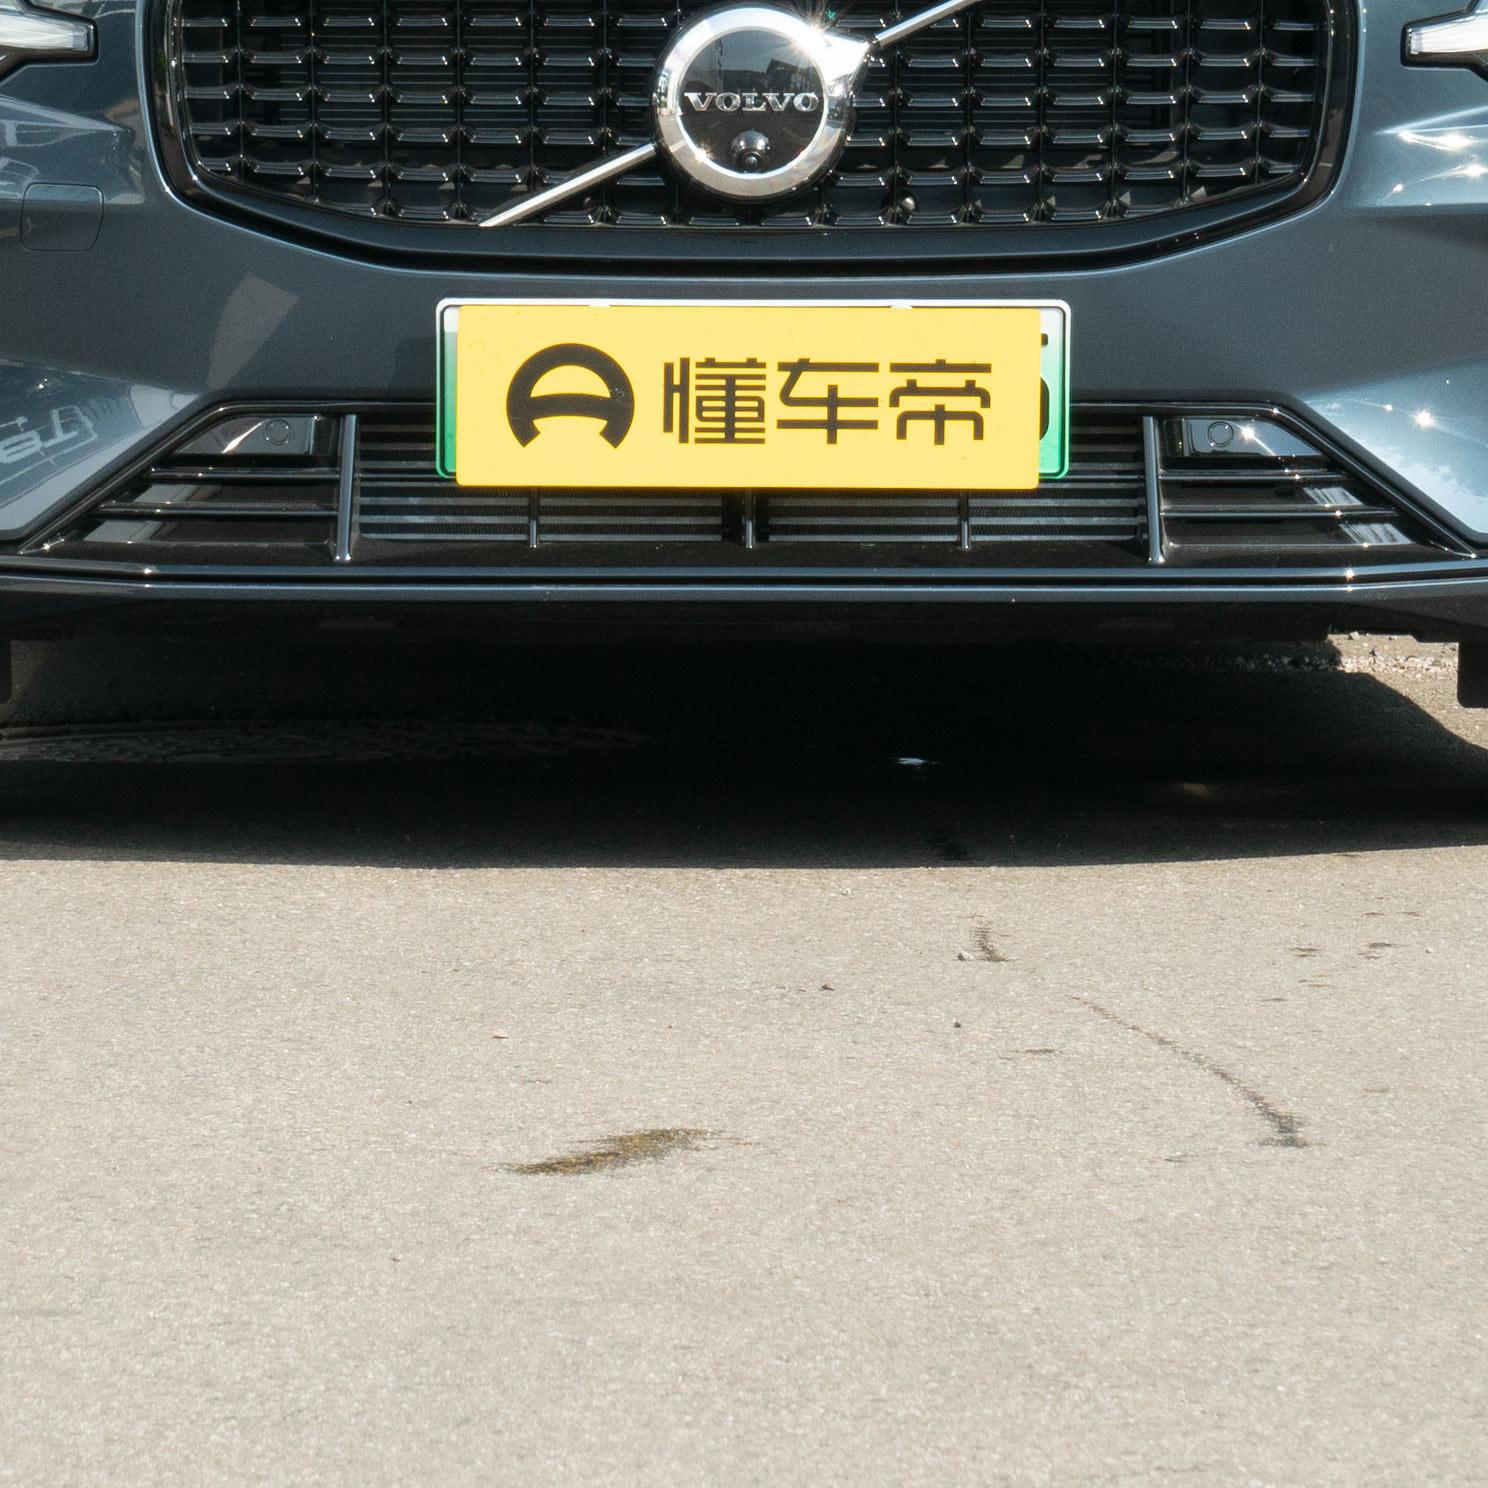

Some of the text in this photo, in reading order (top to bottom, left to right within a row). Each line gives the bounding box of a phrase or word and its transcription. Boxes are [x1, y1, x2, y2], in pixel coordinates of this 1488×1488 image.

[683, 92, 820, 112] VOLVO
[662, 356, 993, 446] 懂车帝
